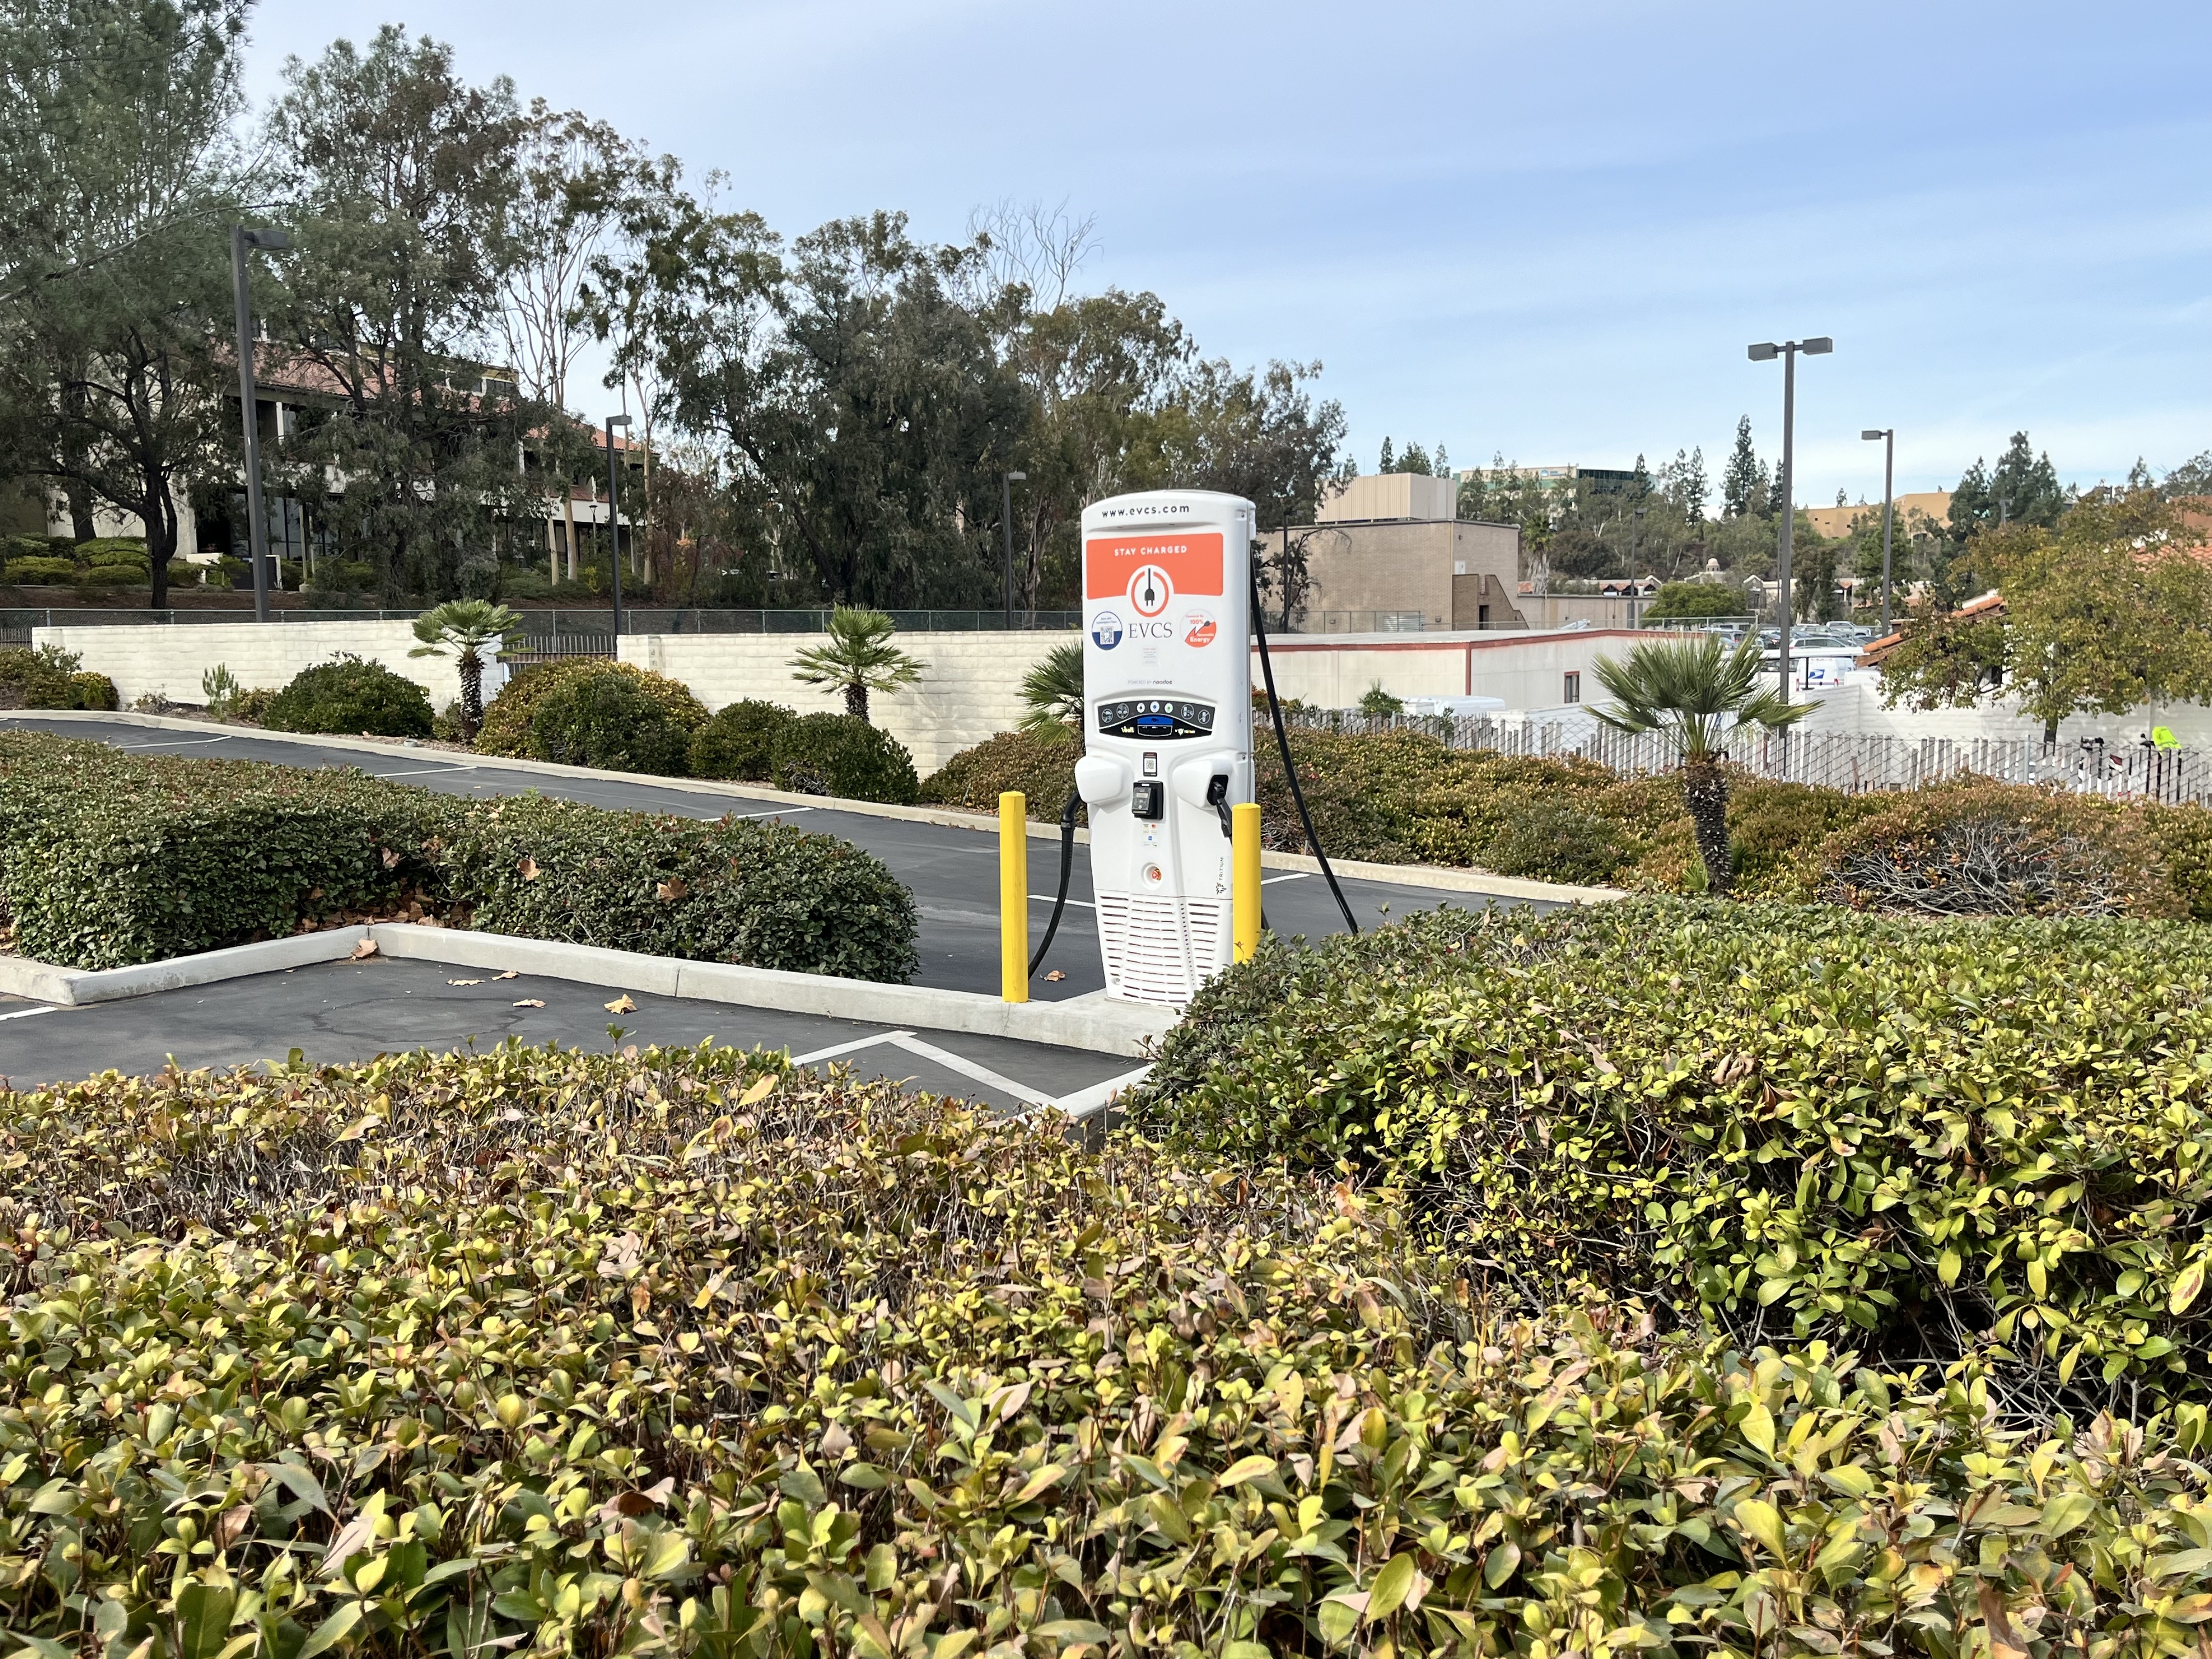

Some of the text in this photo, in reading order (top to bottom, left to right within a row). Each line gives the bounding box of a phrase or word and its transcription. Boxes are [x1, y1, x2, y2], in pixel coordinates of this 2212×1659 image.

[1102, 505, 1189, 518] www.evcs.com
[1114, 545, 1187, 556] STAY CHARGED
[1128, 622, 1172, 639] EVCS
